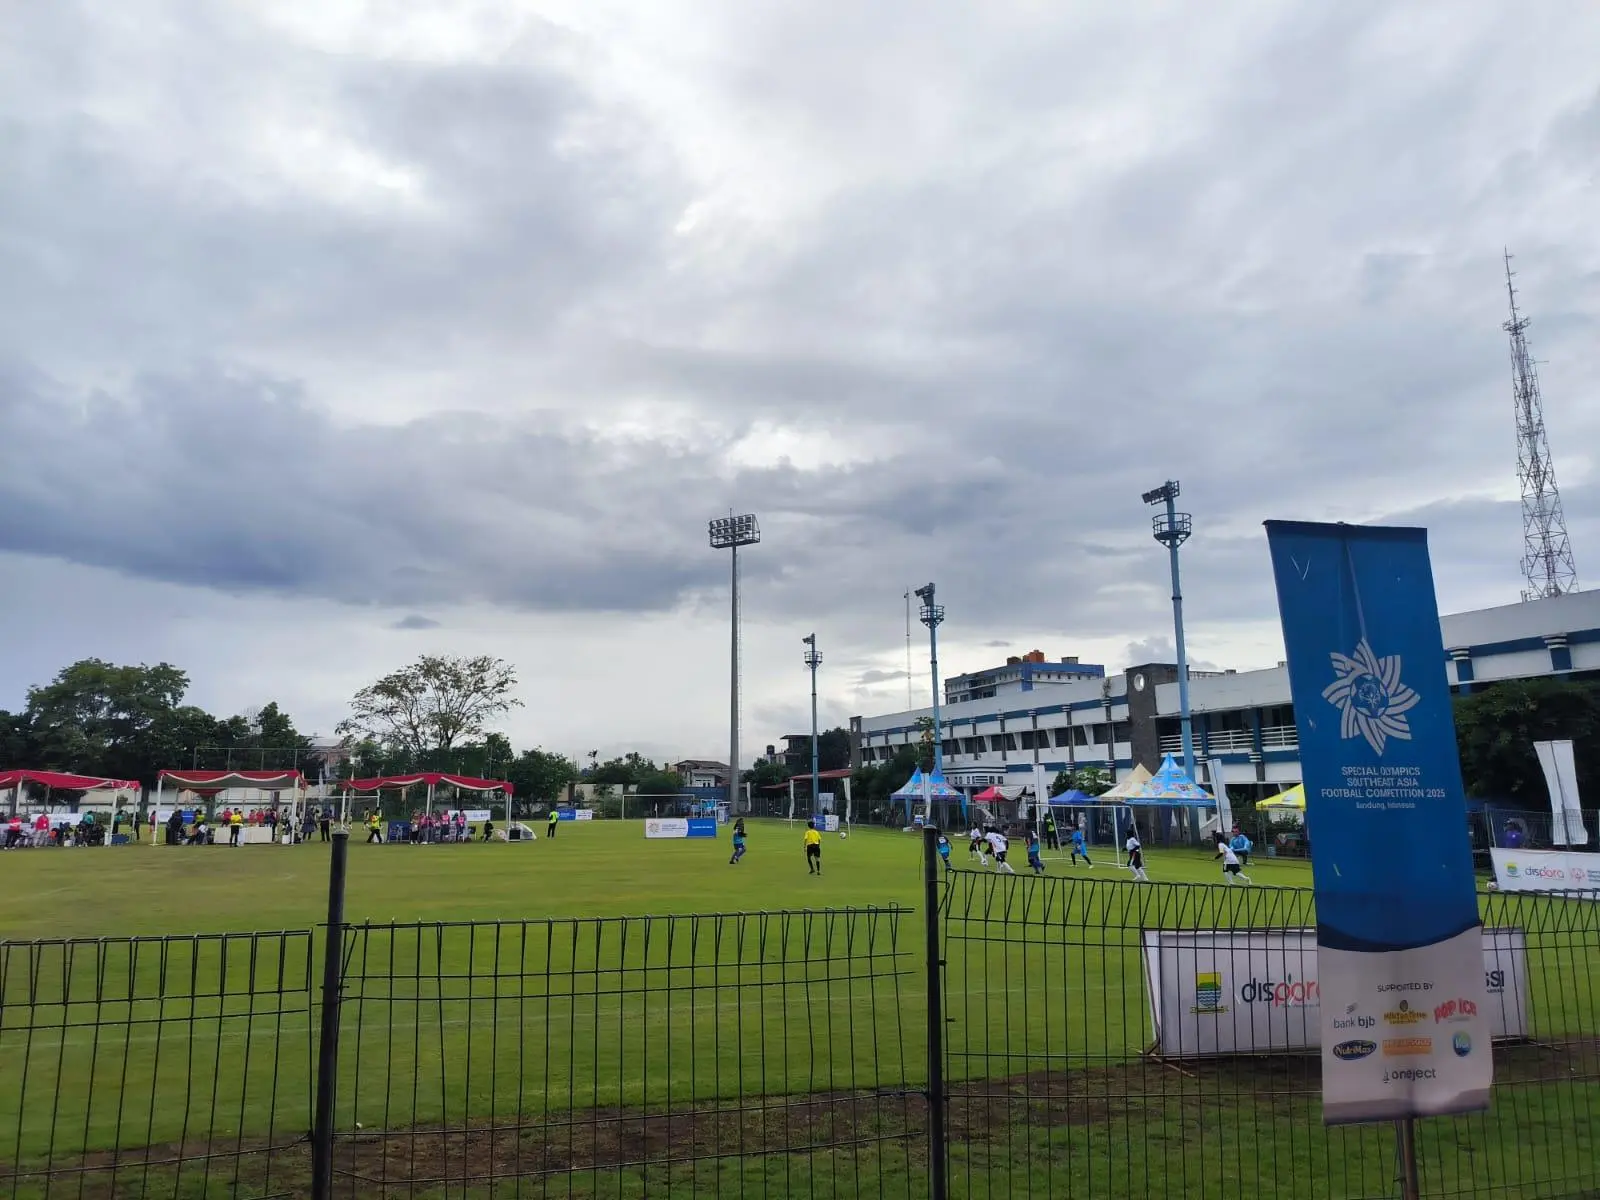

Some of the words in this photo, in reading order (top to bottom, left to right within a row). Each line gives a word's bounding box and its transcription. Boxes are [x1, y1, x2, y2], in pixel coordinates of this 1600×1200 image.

[1341, 766, 1378, 776] SPECIAL
[1380, 766, 1420, 776] OLYMPICS
[1347, 777, 1395, 787] SOUTHEAST
[1397, 777, 1418, 787] ASIA
[1321, 788, 1364, 798] FOOTBALL
[1366, 788, 1424, 798] COMPETITION
[1427, 788, 1446, 798] 2025
[1377, 983, 1421, 992] SUPPORTED
[1423, 982, 1433, 991] BY
[1333, 1017, 1355, 1029] bank
[1358, 1015, 1375, 1029] bjb
[1391, 1067, 1436, 1081] oneject
